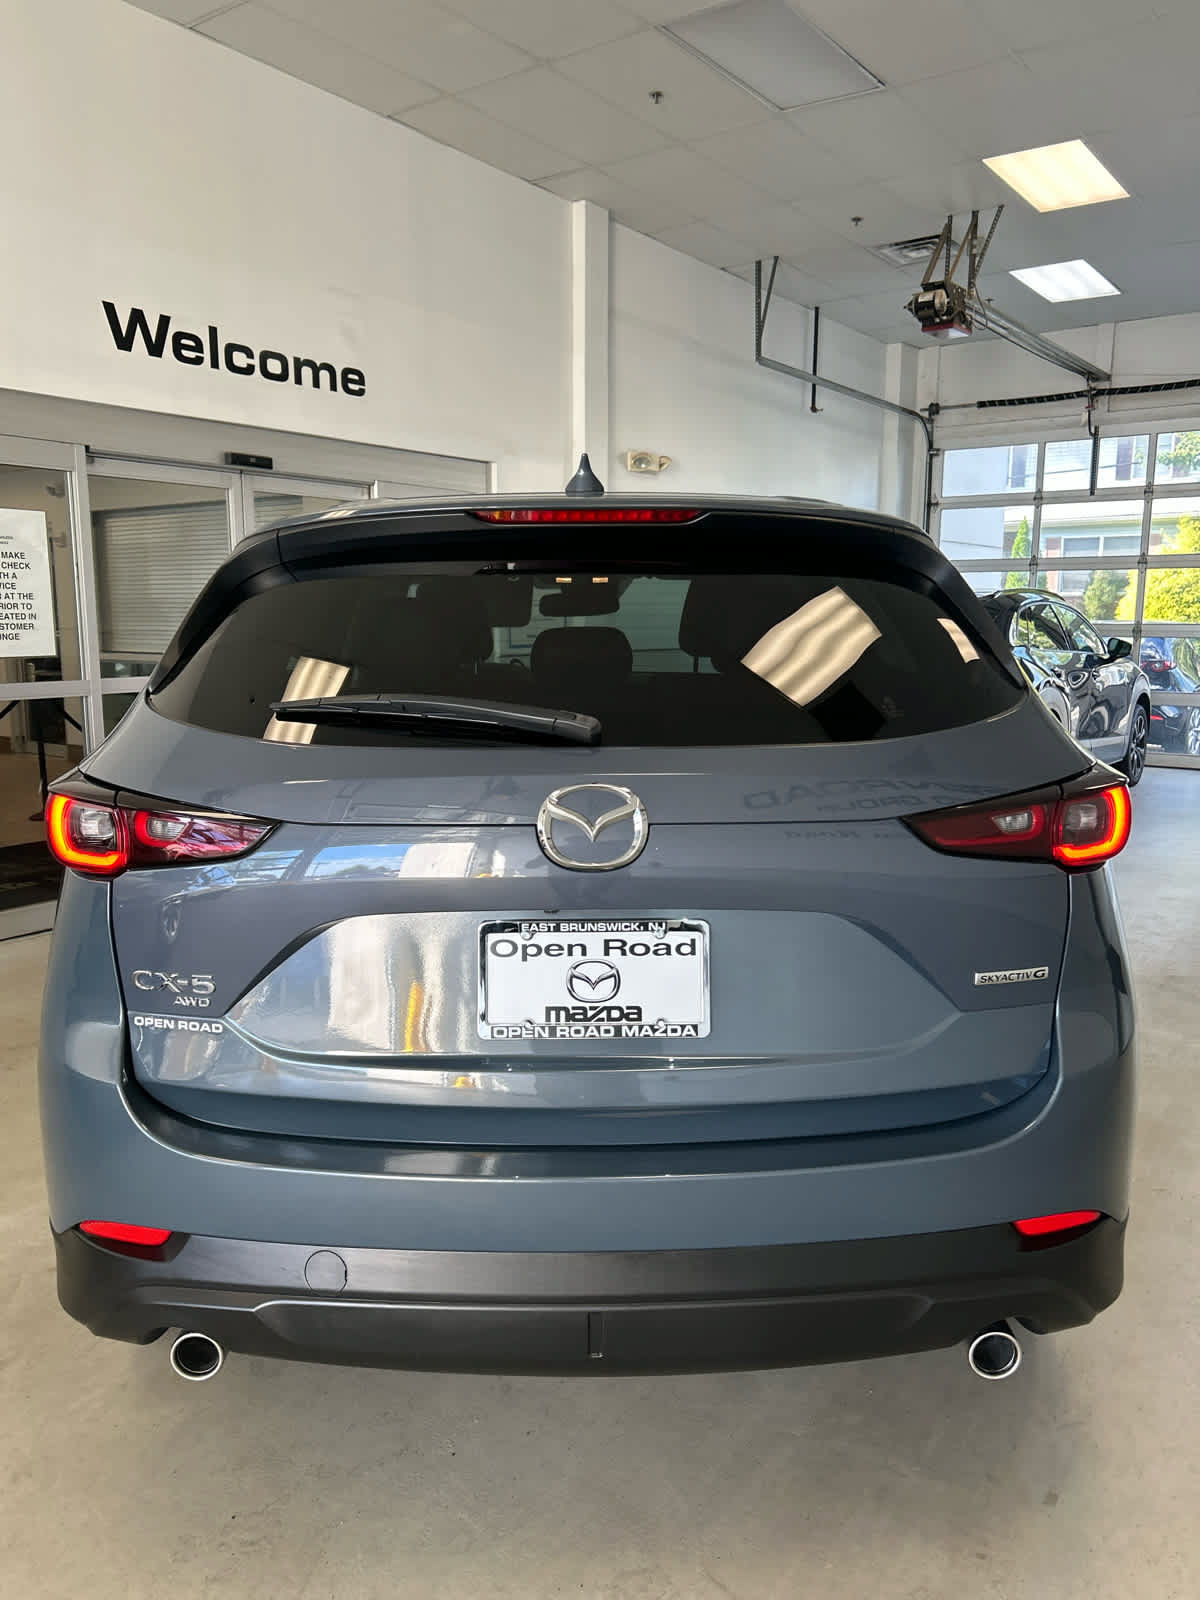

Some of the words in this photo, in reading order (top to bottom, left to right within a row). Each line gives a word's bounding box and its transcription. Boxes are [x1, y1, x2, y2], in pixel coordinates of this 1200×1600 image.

[102, 300, 366, 397] Welcome
[1, 551, 25, 560] MAKE
[1, 561, 31, 570] CHECK
[12, 572, 17, 580] A
[5, 592, 14, 600] AT
[17, 592, 33, 600] THE
[21, 602, 32, 610] TO
[521, 923, 556, 932] EAST
[648, 922, 666, 931] NJ
[490, 939, 587, 962] Open
[604, 938, 696, 957] Road
[133, 970, 216, 994] CX-5
[174, 996, 210, 1008] AWD
[134, 1016, 175, 1029] OPEN
[178, 1020, 223, 1033] ROAD
[493, 1026, 549, 1038] OPEN
[556, 1026, 615, 1038] ROAD
[621, 1025, 697, 1037] MAZDA
